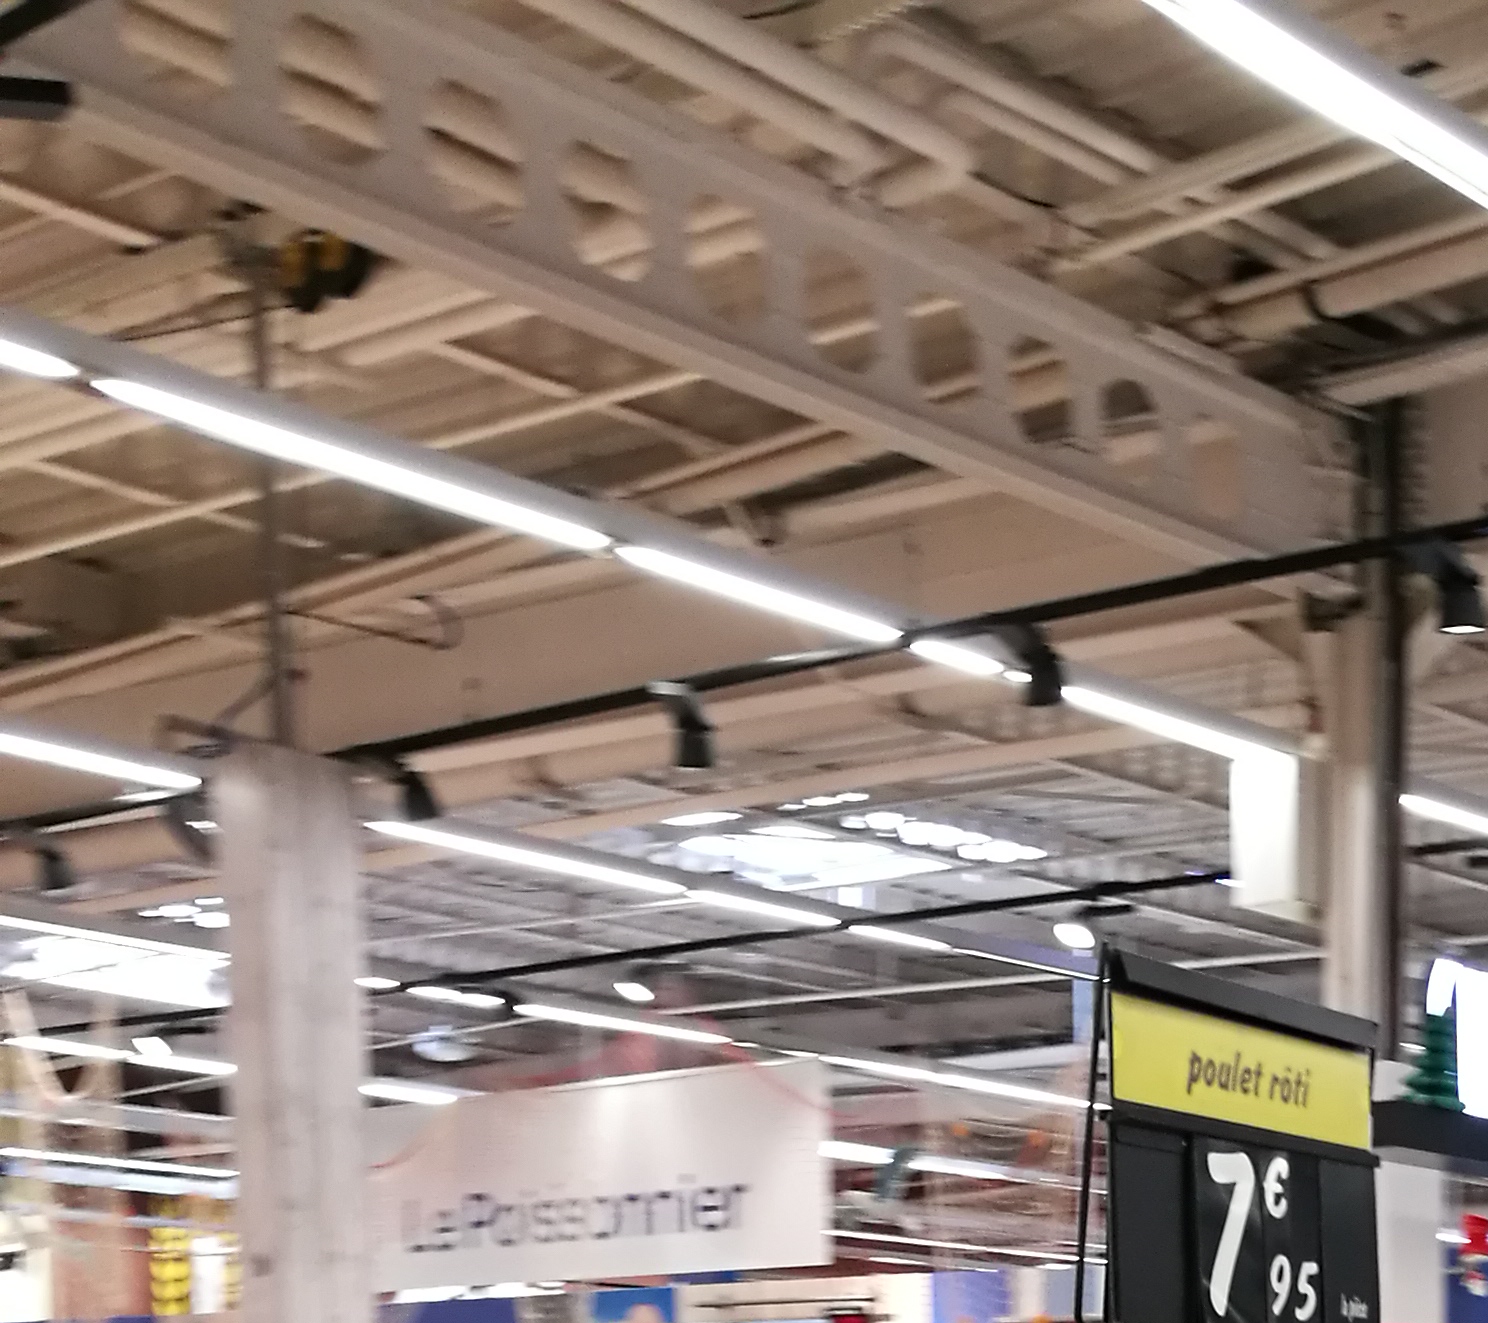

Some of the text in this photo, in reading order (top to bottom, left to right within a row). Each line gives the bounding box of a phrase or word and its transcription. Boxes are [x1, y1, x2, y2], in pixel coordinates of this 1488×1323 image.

[1187, 1051, 1309, 1108] poulet rôti
[460, 1172, 754, 1247] Poissonnier
[1206, 1152, 1291, 1317] 7 €
[1269, 1253, 1319, 1321] 95
